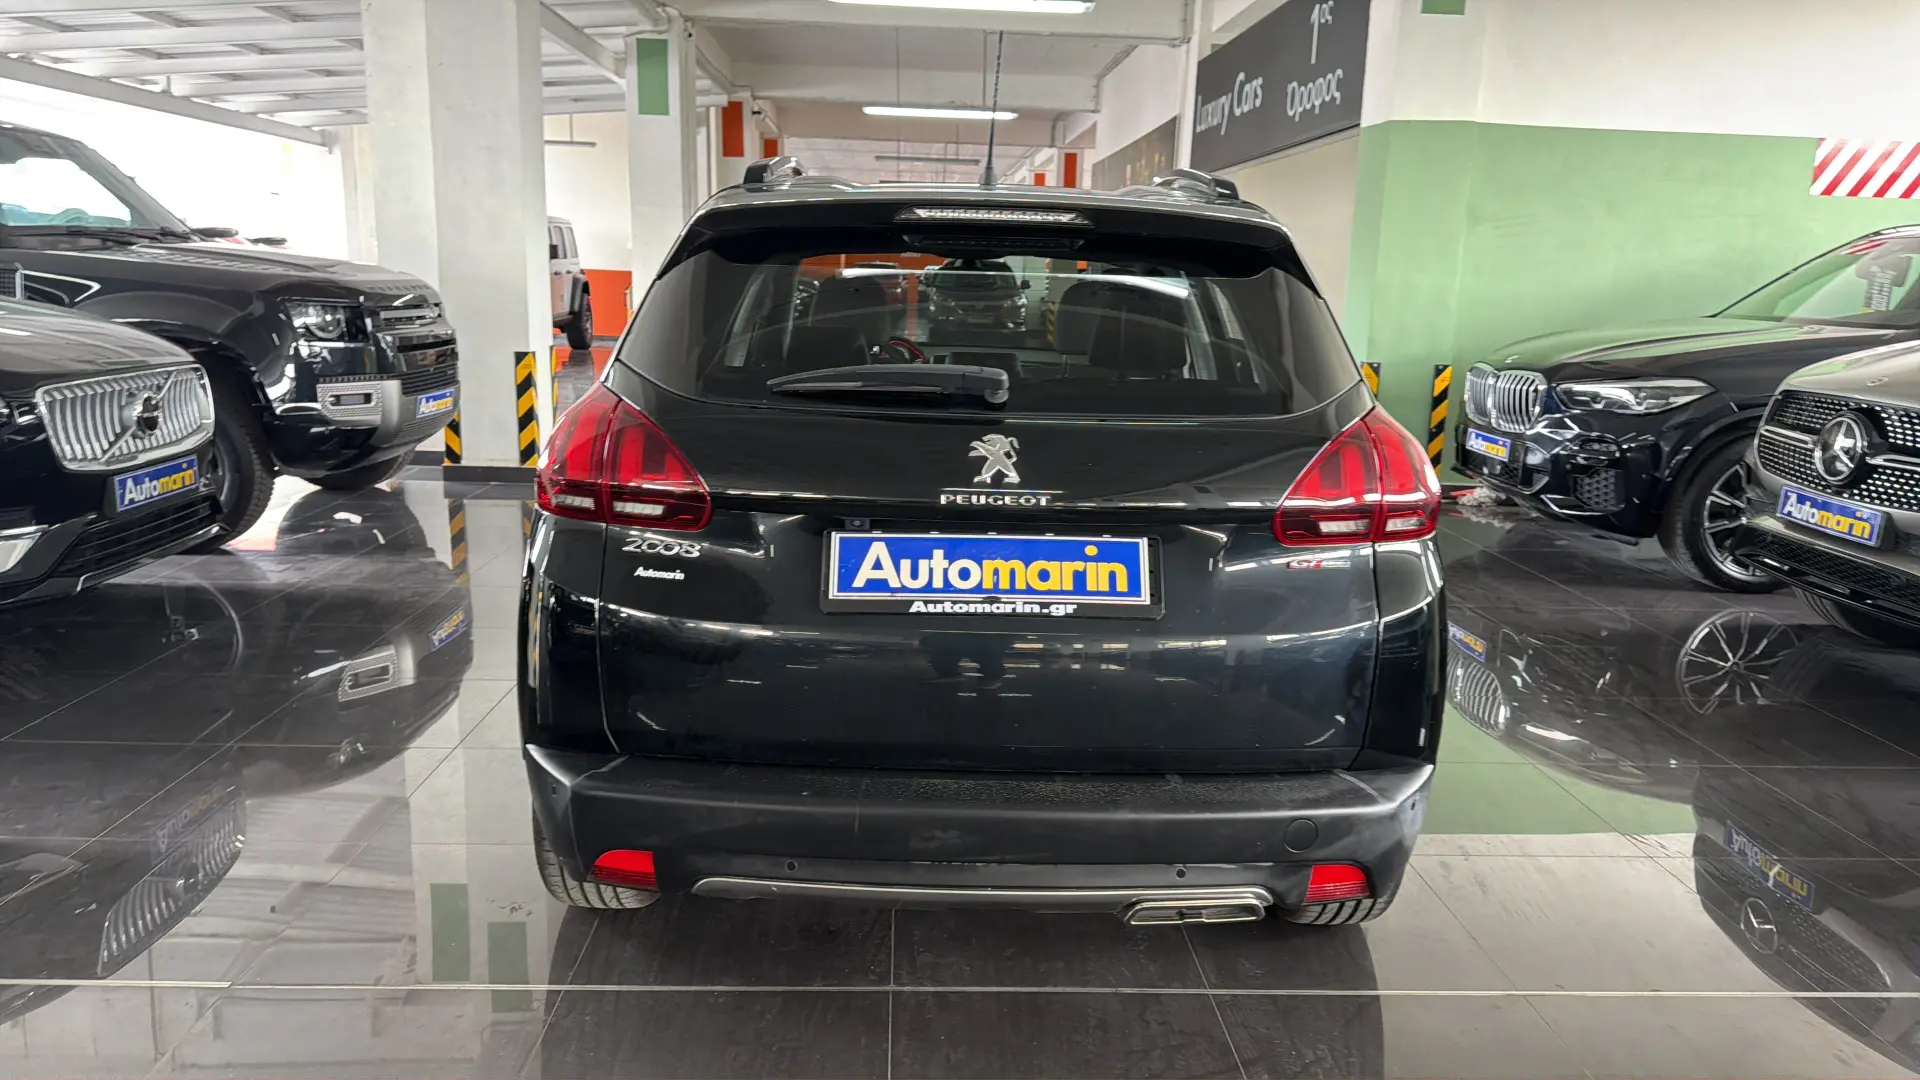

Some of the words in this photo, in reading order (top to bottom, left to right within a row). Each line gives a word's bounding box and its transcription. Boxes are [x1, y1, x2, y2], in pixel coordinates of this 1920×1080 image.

[1196, 93, 1232, 135] Luxury
[1233, 72, 1263, 116] Cars
[123, 462, 196, 505] Automarin
[940, 494, 1051, 507] PEUGEOT
[1782, 492, 1871, 539] Automarin
[622, 538, 701, 558] 2008
[634, 566, 685, 580] Automarin
[851, 541, 1128, 592] Automarin
[909, 600, 1078, 617] Automarin.gr
